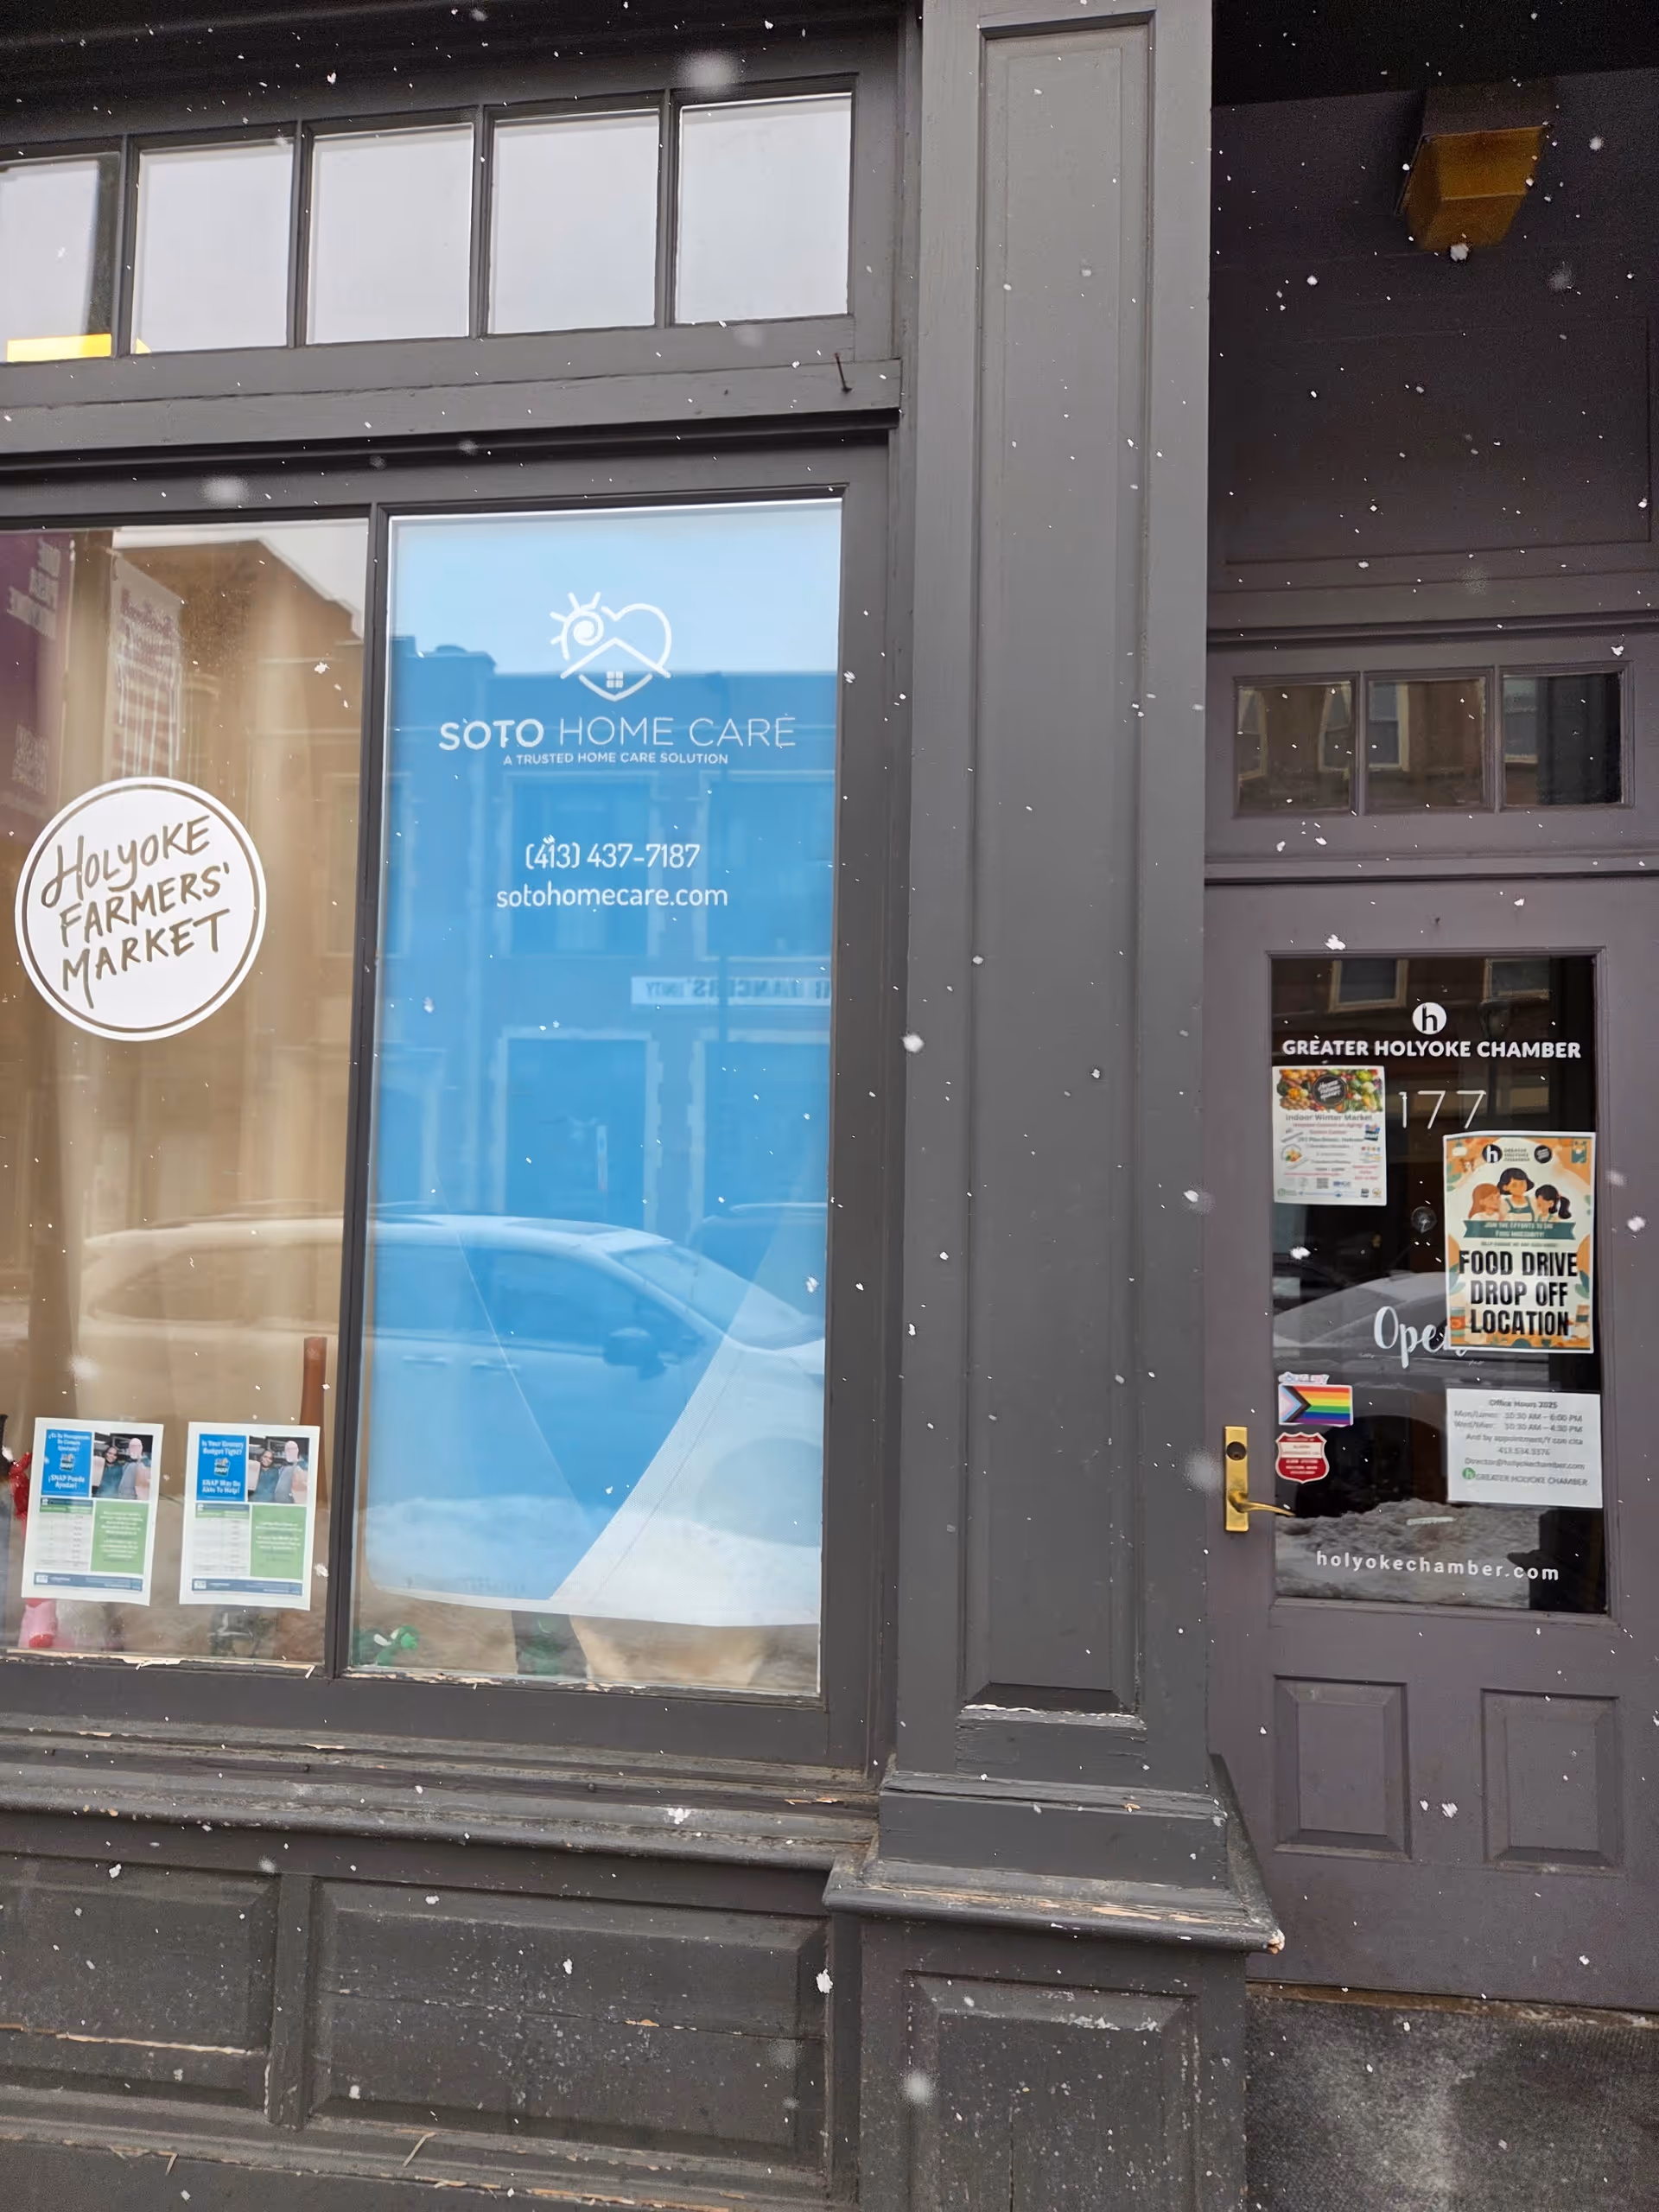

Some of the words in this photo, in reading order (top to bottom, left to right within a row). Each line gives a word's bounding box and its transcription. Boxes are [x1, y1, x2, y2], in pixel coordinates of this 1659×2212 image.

[438, 719, 545, 751] SOTO
[560, 715, 674, 747] HOME
[689, 716, 797, 747] CARE
[503, 754, 513, 766] A
[518, 753, 575, 765] TRUSTED
[577, 753, 617, 764] HOME
[620, 753, 657, 764] CARE
[660, 753, 728, 765] SOLUTION
[41, 814, 211, 908] HOLYOKE
[525, 842, 582, 870] (413)
[587, 842, 701, 869] 437-7187
[495, 880, 728, 908] sotohomecare.com
[61, 907, 232, 1010] MARKET
[1282, 1039, 1370, 1056] GREATER
[1374, 1039, 1471, 1058] HOLYOKE
[1476, 1040, 1582, 1058] CHAMBER
[1398, 1090, 1487, 1130] 177
[1459, 1250, 1514, 1275] FOOD
[1522, 1251, 1578, 1277] DRIVE
[1471, 1281, 1528, 1306] DROP
[1535, 1281, 1568, 1306] OFF
[1471, 1309, 1569, 1336] LOCATION
[1374, 1306, 1465, 1370] Ope
[1569, 1414, 1583, 1422] PM
[1316, 1550, 1560, 1580] holyokechamber.com
